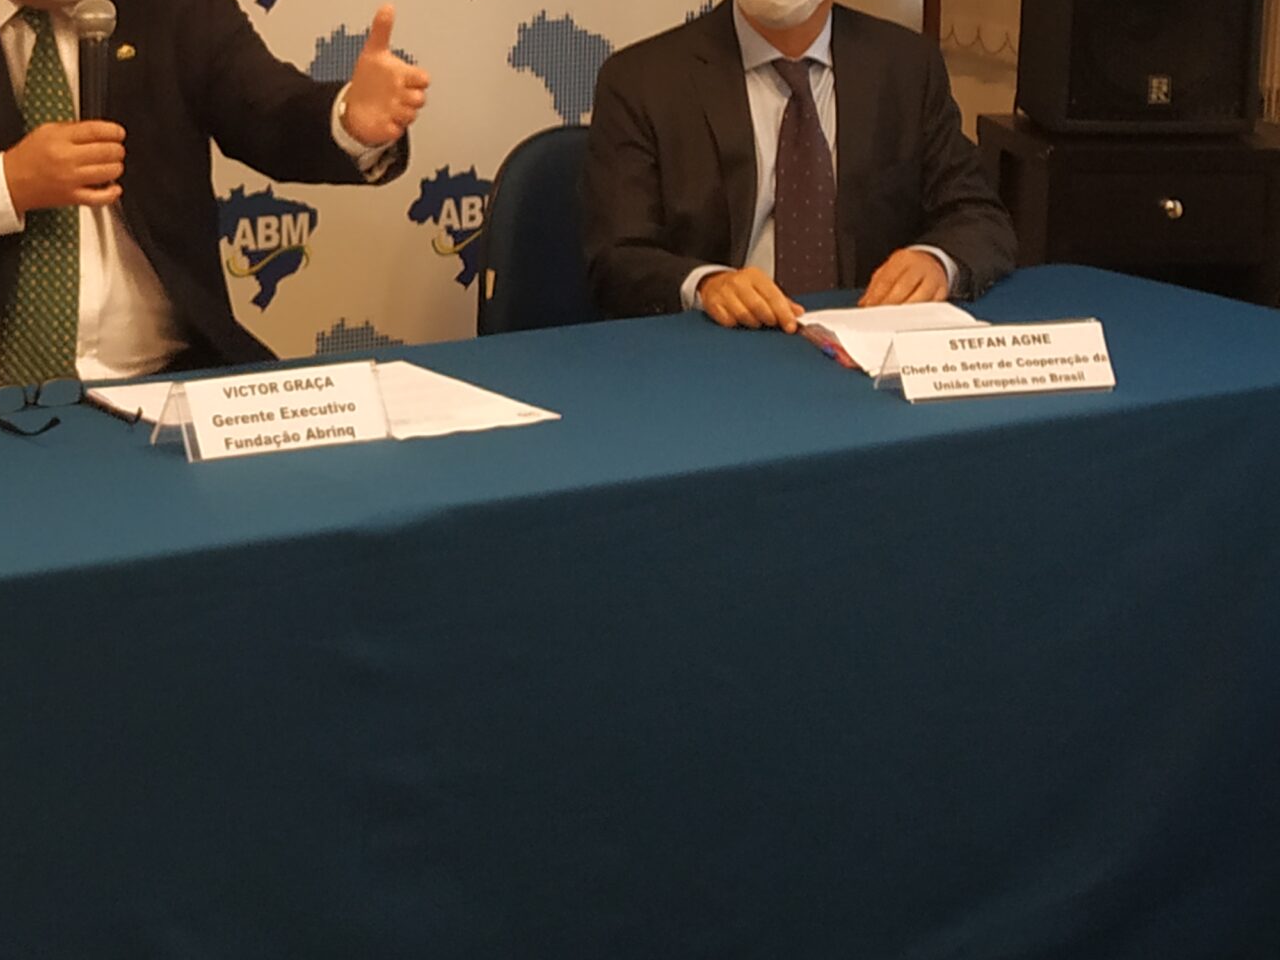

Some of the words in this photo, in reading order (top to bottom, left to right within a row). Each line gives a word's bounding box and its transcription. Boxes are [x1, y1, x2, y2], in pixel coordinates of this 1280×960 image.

[438, 194, 489, 230] AB
[234, 214, 309, 251] ABM
[949, 336, 1006, 350] STEFAN
[1011, 333, 1051, 346] AGNE
[902, 364, 938, 375] Chefe
[942, 362, 957, 372] do
[961, 360, 993, 371] Setor
[997, 359, 1013, 369] de
[1016, 353, 1089, 367] Cooperação
[223, 381, 279, 399] VICTOR
[283, 376, 334, 392] GRAÇA
[933, 380, 970, 391] União
[973, 376, 1028, 388] Europeia
[1032, 376, 1046, 385] no
[1049, 371, 1086, 382] Brasil
[212, 411, 275, 427] Gerente
[280, 401, 356, 419] Executivo
[224, 431, 301, 450] Fundação
[306, 424, 356, 440] Abrinq
